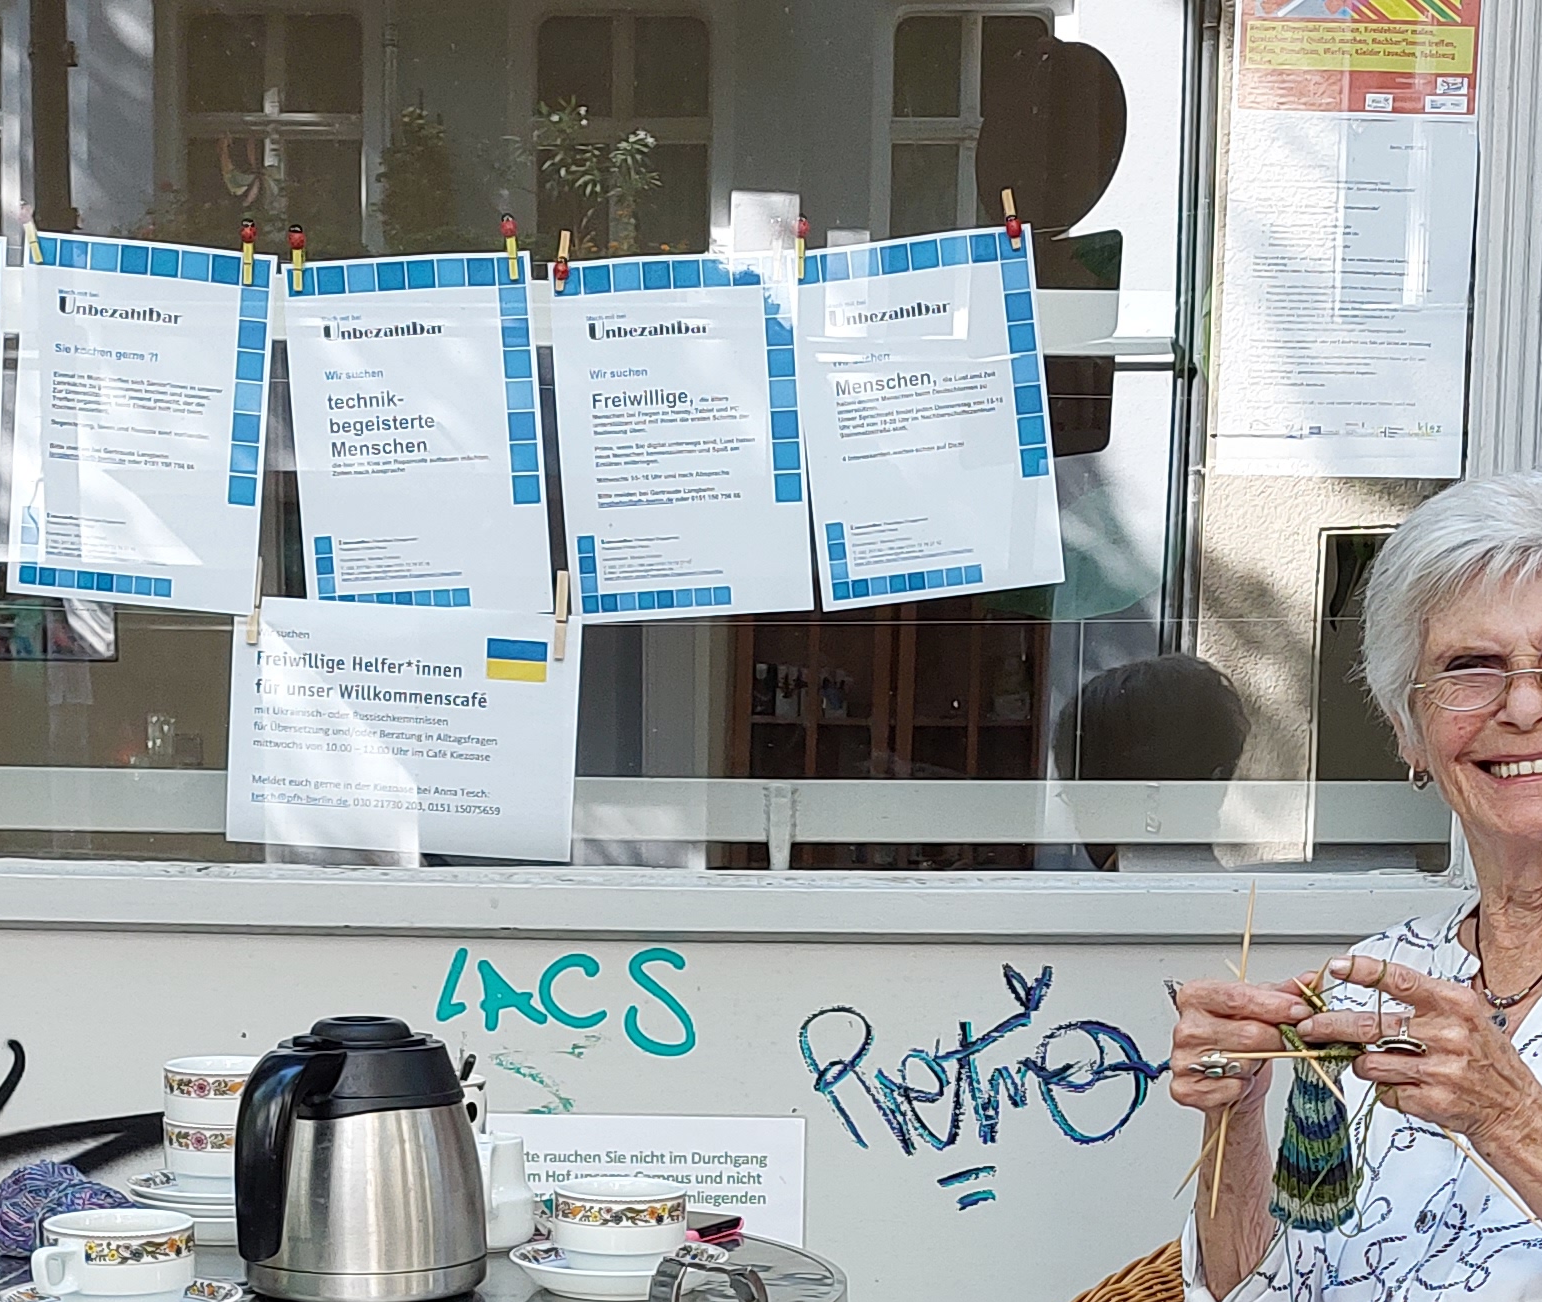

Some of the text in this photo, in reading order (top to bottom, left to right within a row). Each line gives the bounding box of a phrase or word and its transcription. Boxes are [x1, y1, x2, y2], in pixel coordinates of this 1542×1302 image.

[59, 295, 184, 325] Unbezahlbar
[828, 302, 951, 328] Unbezahlbar
[323, 321, 445, 341] Unbezahlbar
[588, 320, 710, 341] Unbezahlbar
[55, 343, 72, 354] Sie
[324, 369, 384, 380] Wir suchen
[589, 368, 648, 380] Wir suchen
[835, 372, 938, 397] Menschen,
[327, 390, 405, 411] technik-
[592, 389, 694, 410] Freiwillige,
[329, 414, 435, 437] begeisterte
[277, 631, 310, 640] suchen
[256, 651, 346, 674] Freiwillige
[255, 678, 488, 708] für unser Willkommenscafé
[254, 705, 270, 715] mit
[328, 710, 350, 719] oder
[254, 720, 268, 731] für
[270, 720, 330, 736] Übersetzung
[379, 730, 422, 743] Beratung
[425, 732, 433, 742] in
[436, 733, 498, 747] Alltagsfragen
[253, 738, 303, 750] mittwochs
[392, 746, 409, 757] Uhr
[412, 748, 423, 757] im
[426, 748, 447, 760] Café
[450, 750, 491, 762] Kiezoase
[251, 774, 286, 787] Meldet
[288, 776, 311, 788] euch
[344, 781, 352, 790] in
[417, 785, 431, 796] bei
[433, 786, 457, 798] Anna
[353, 797, 372, 808] 030
[373, 798, 403, 810] 21730
[427, 802, 452, 813] 0151
[454, 803, 501, 816] 15075659
[544, 1149, 601, 1164] rauchen
[606, 1151, 626, 1164] Sie
[630, 1150, 665, 1165] nicht
[669, 1151, 687, 1165] im
[691, 1152, 768, 1168] Durchgang
[545, 1170, 572, 1183] Hof
[695, 1171, 724, 1185] und
[727, 1171, 763, 1186] nicht
